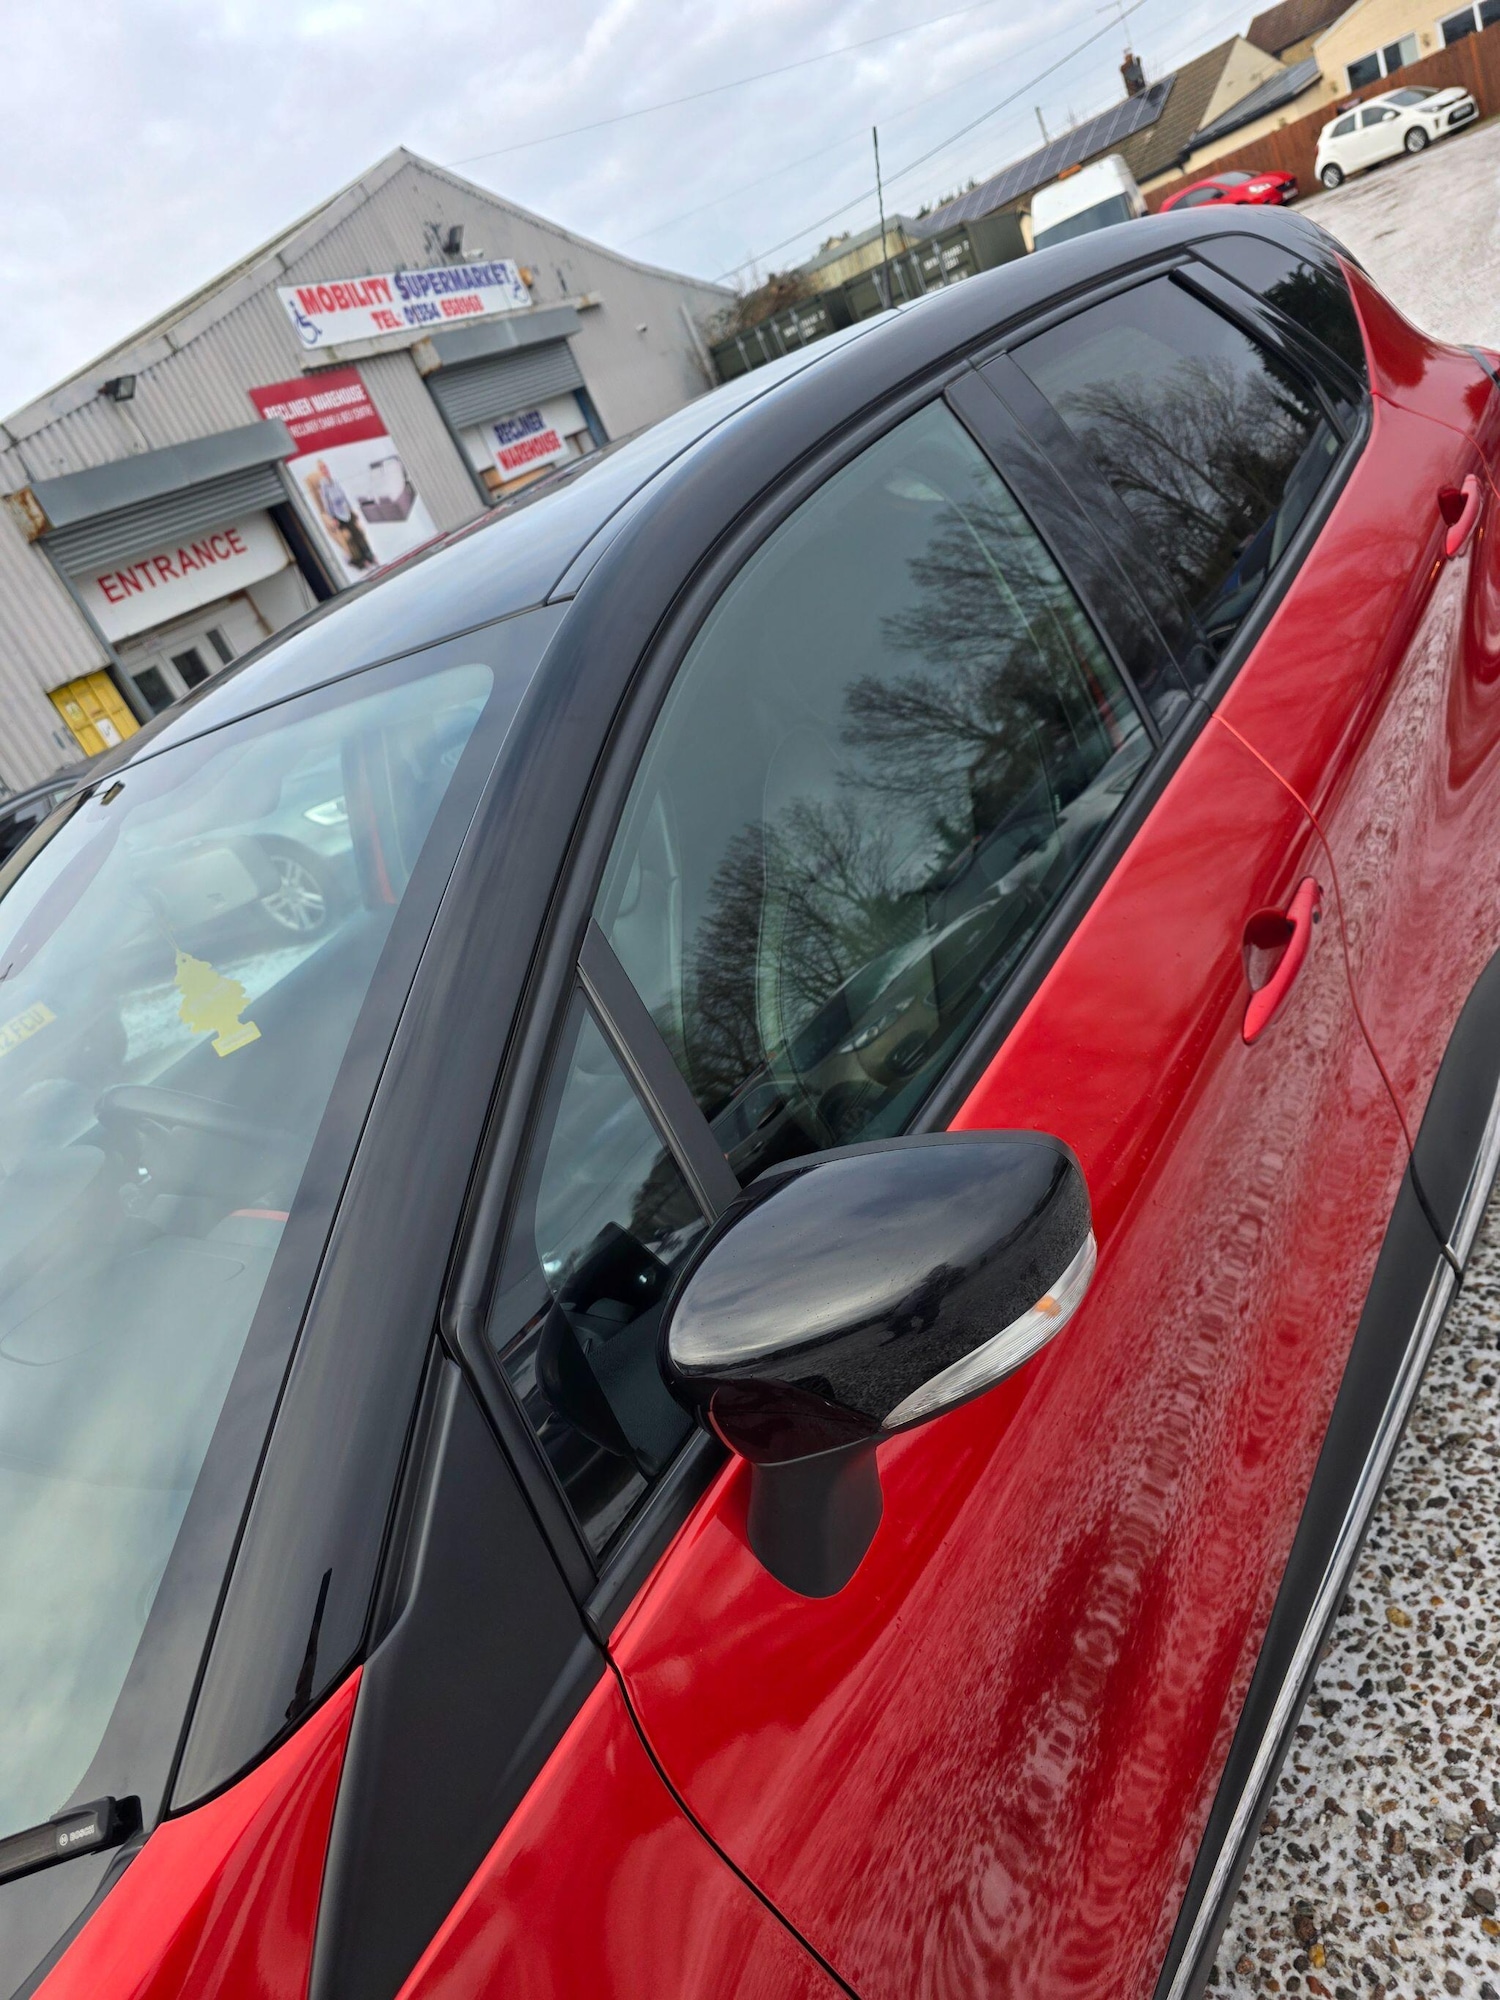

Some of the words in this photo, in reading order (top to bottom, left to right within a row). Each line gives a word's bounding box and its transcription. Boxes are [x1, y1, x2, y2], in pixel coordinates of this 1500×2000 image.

[297, 278, 394, 315] MOBILITY
[394, 262, 511, 300] SUPERMARKET
[263, 396, 313, 421] RECLINER
[310, 384, 367, 412] WAREHOUSE
[494, 410, 546, 445] RECLINER
[497, 429, 562, 471] WAREHOUSE
[97, 528, 248, 604] ENTRANCE
[69, 1824, 95, 1842] BOSCH
